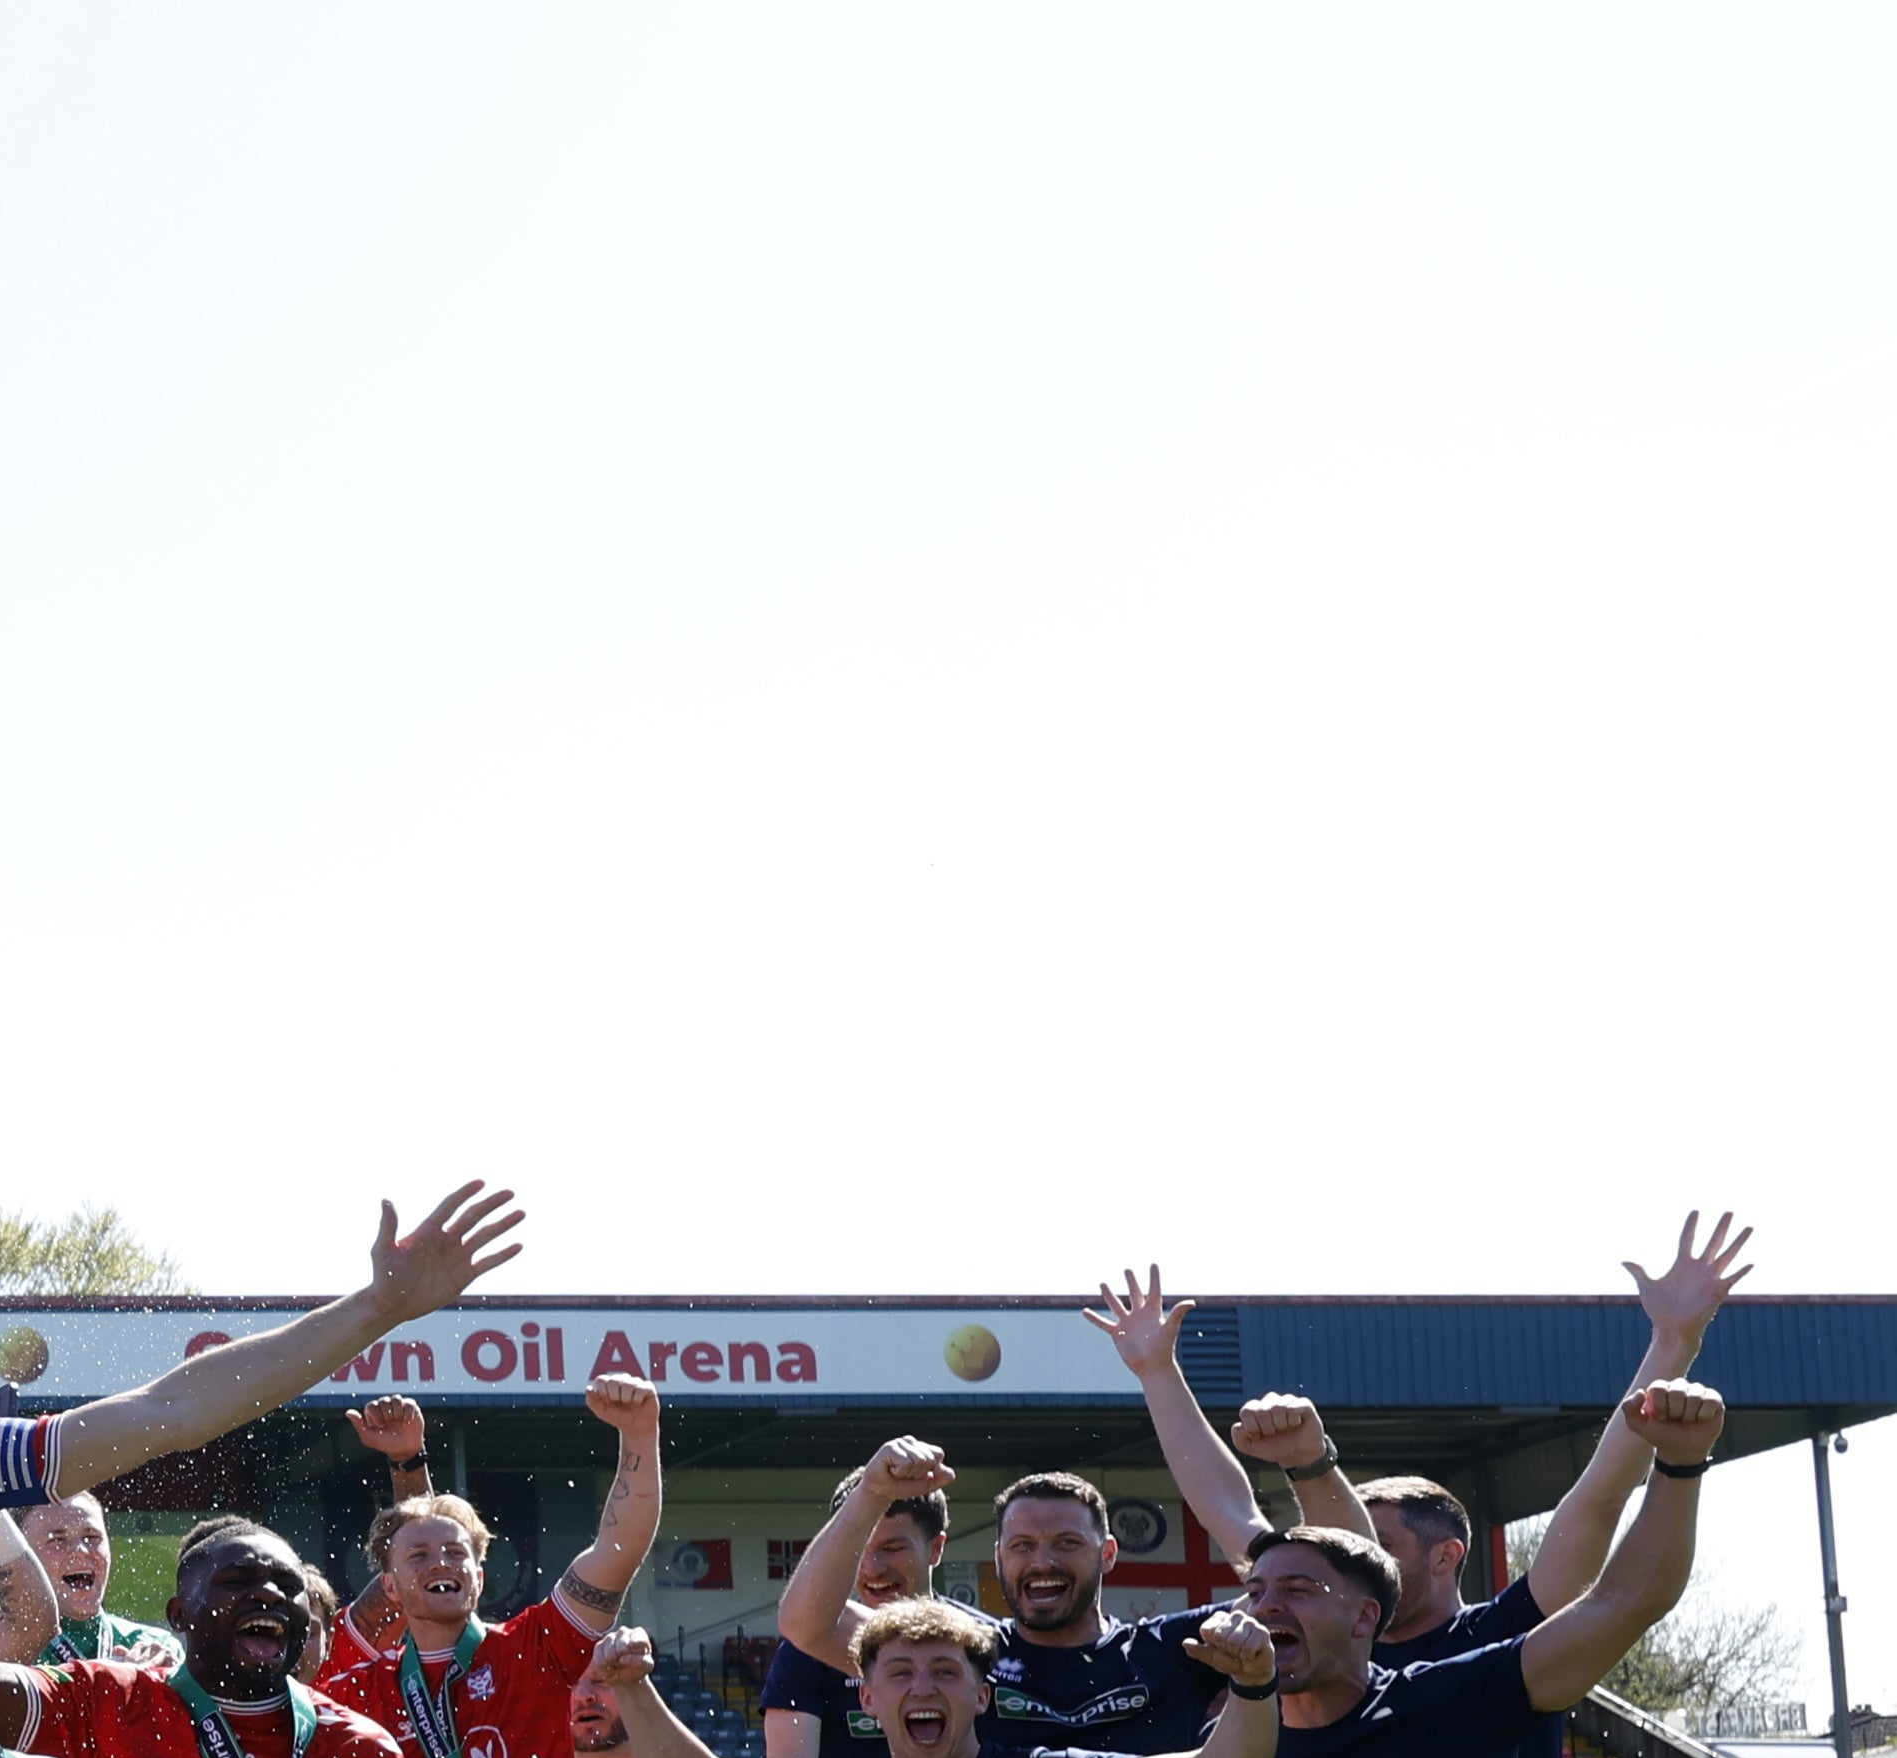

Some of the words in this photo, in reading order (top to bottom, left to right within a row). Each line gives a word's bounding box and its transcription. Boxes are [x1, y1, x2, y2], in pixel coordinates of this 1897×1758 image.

[461, 1322, 565, 1383] Oil
[589, 1330, 819, 1383] Arena
[407, 1677, 444, 1758] enterprise
